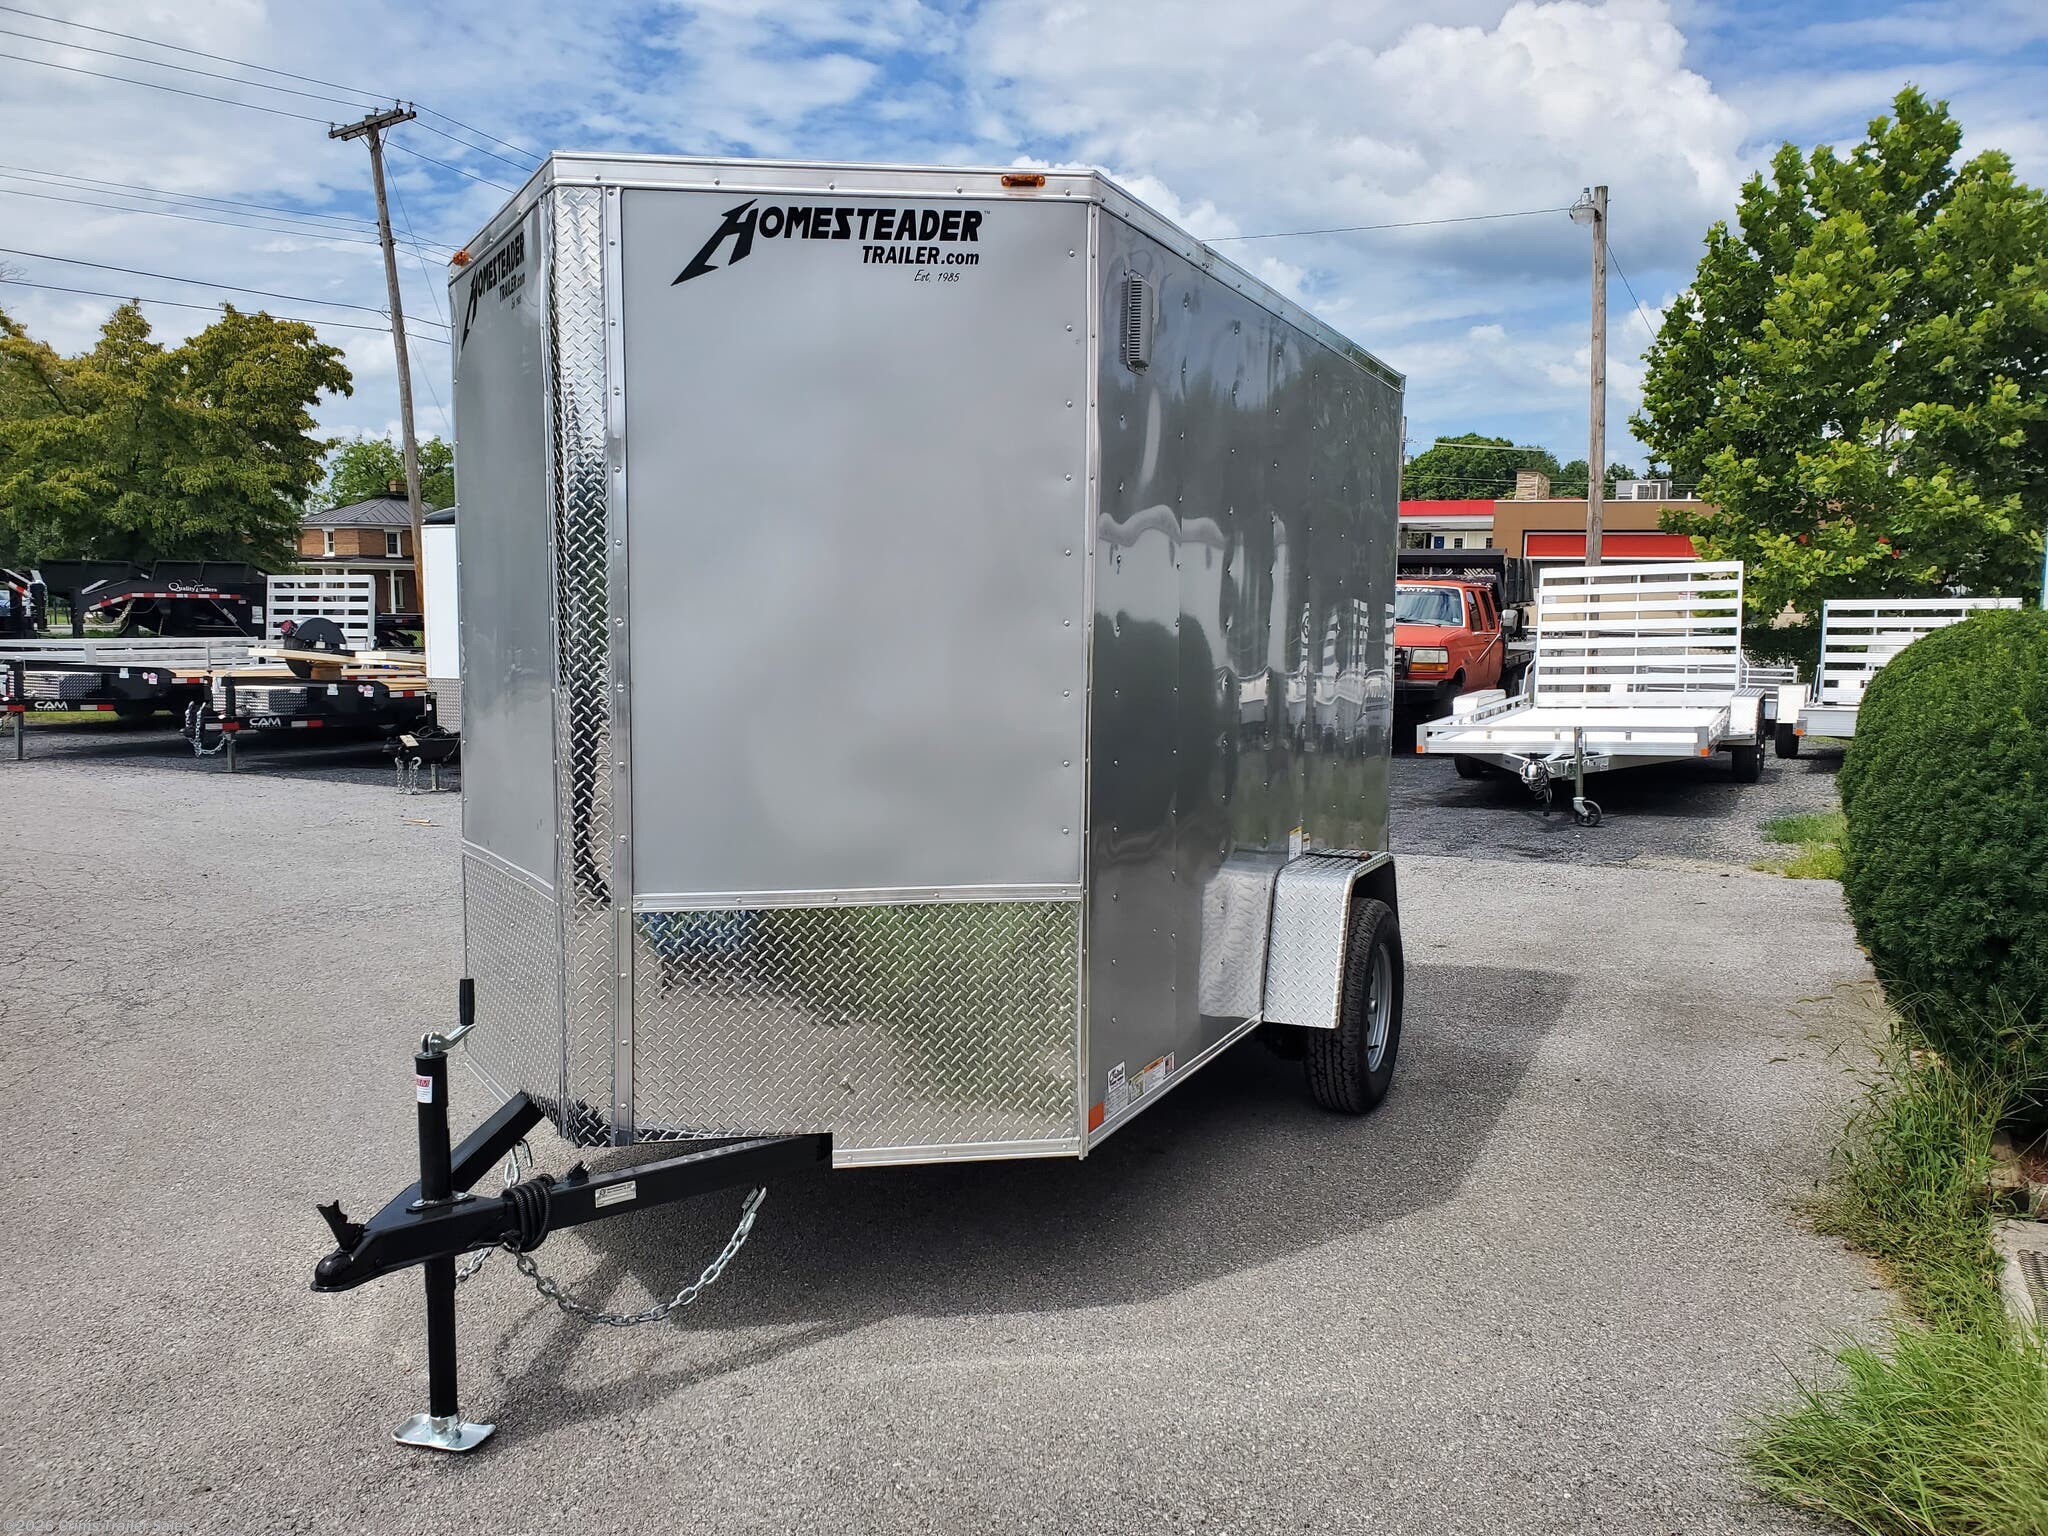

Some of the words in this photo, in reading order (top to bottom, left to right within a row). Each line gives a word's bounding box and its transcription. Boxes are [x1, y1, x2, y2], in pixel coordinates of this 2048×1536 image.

[671, 199, 980, 286] HOMESTEADER
[937, 272, 961, 283] 1985
[461, 231, 525, 351] HOMESTEADER
[34, 701, 68, 710] CAM
[249, 718, 281, 727] CAM
